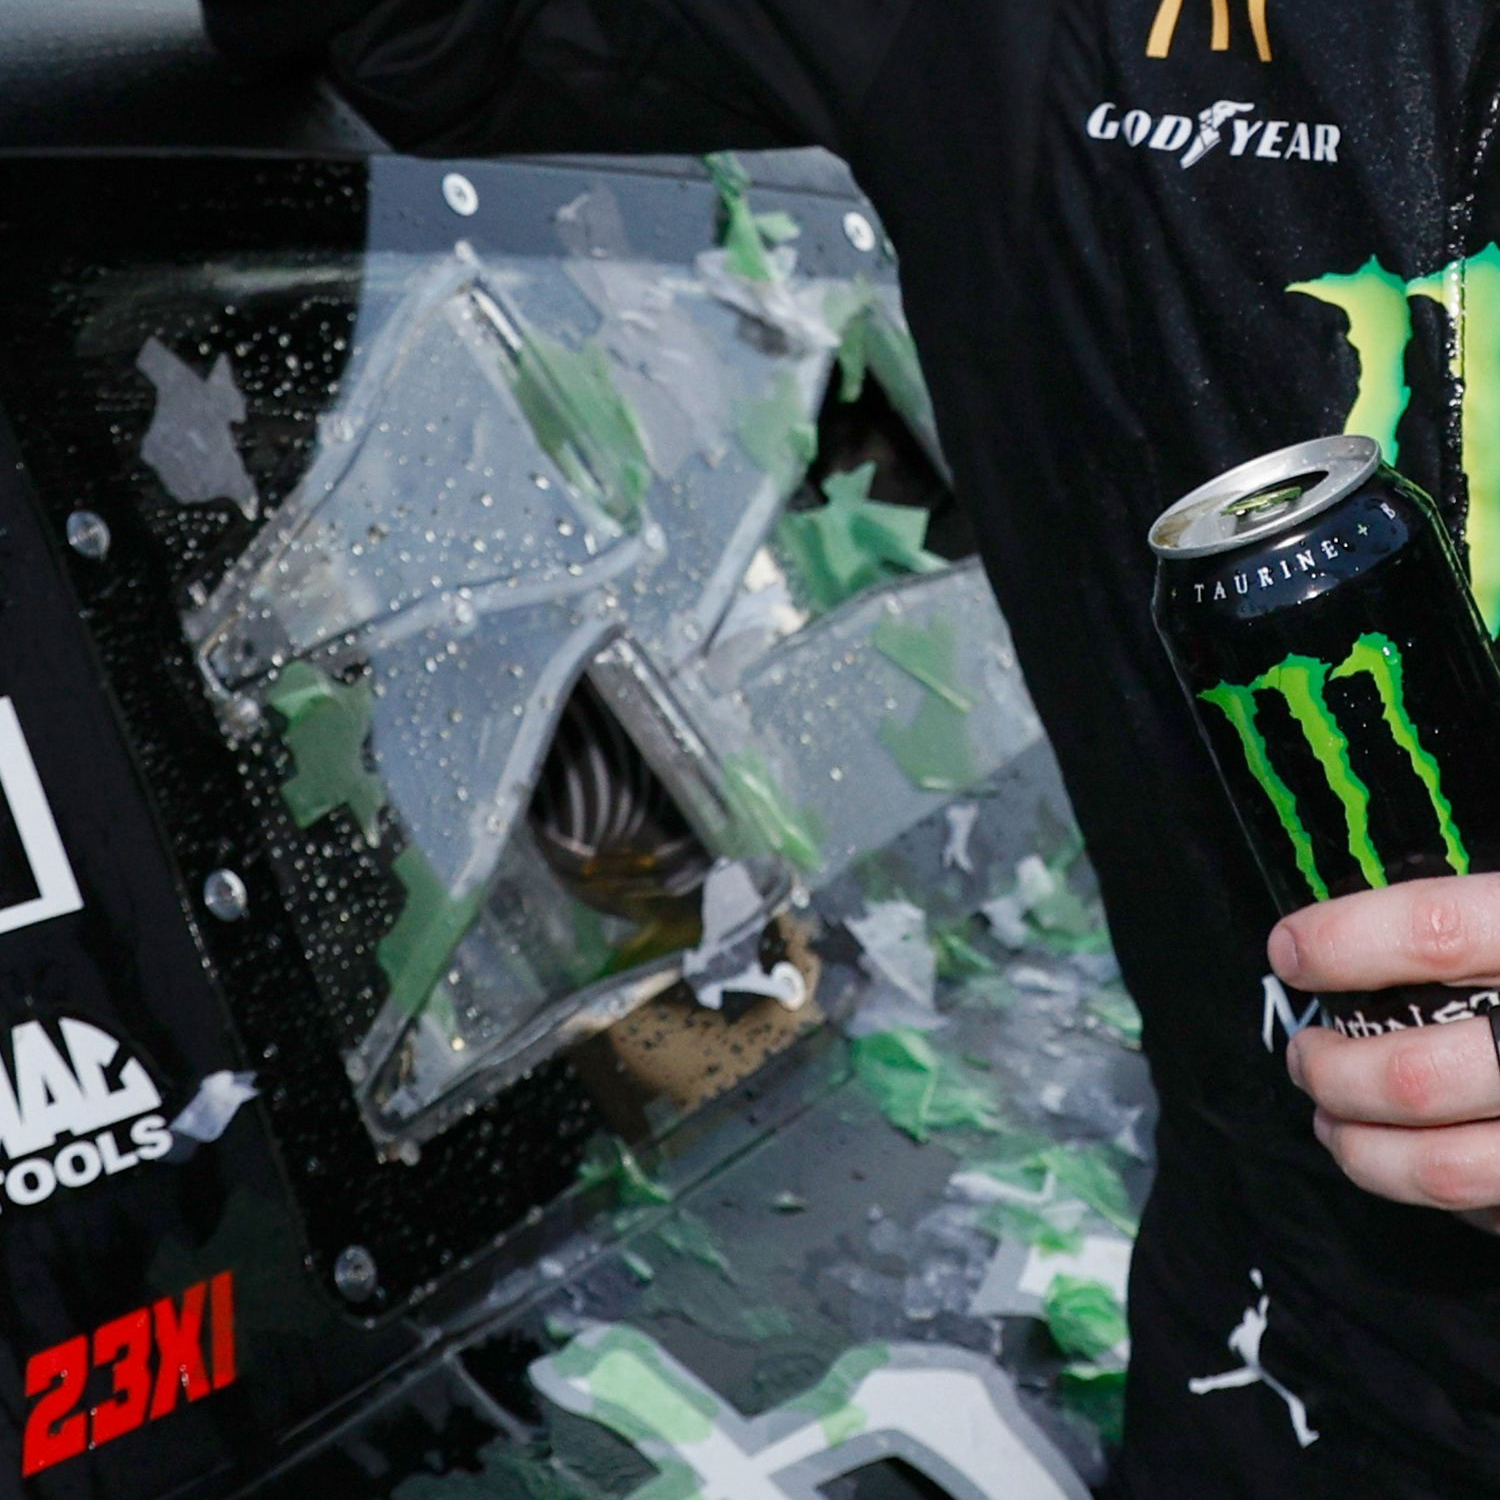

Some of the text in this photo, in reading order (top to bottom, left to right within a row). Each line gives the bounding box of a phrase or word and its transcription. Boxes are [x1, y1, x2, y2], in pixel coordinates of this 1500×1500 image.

[1194, 538, 1340, 602] TAURINE
[0, 1114, 174, 1215] OOLS
[21, 1270, 237, 1477] 23XI
